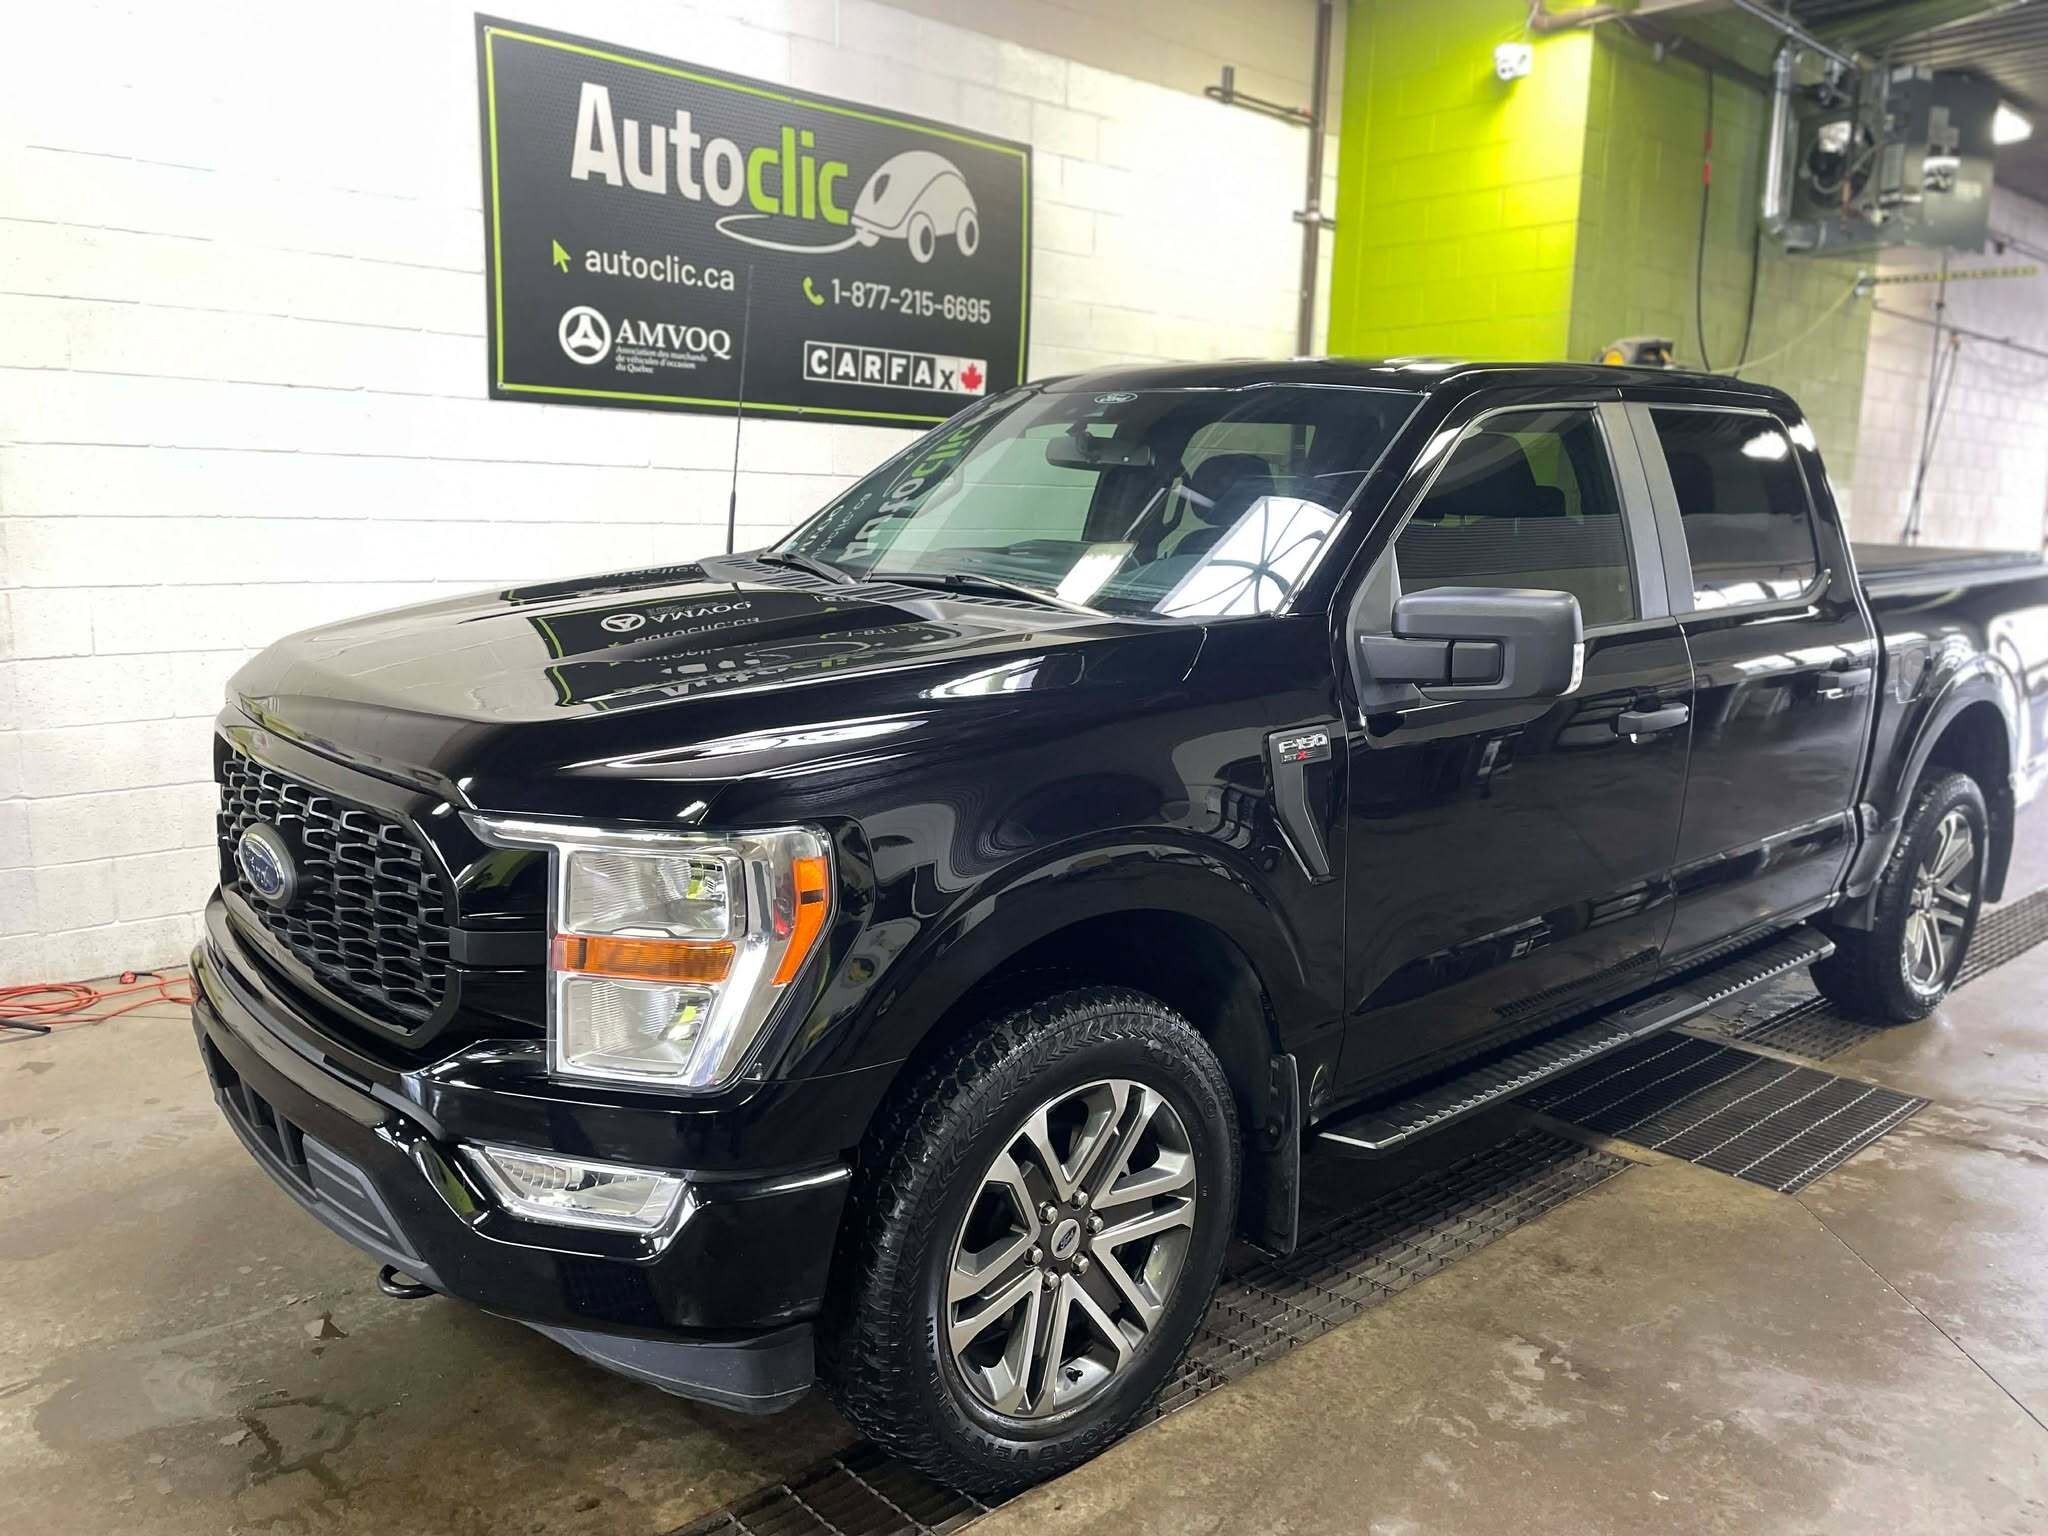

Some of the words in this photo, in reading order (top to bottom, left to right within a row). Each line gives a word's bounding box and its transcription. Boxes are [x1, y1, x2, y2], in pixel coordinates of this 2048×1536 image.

[571, 81, 849, 226] Autoclic
[585, 249, 735, 291] autoclic.ca
[831, 278, 992, 324] 1-877-215-6695
[615, 318, 732, 360] AMVOQ
[810, 349, 954, 391] CARFAX
